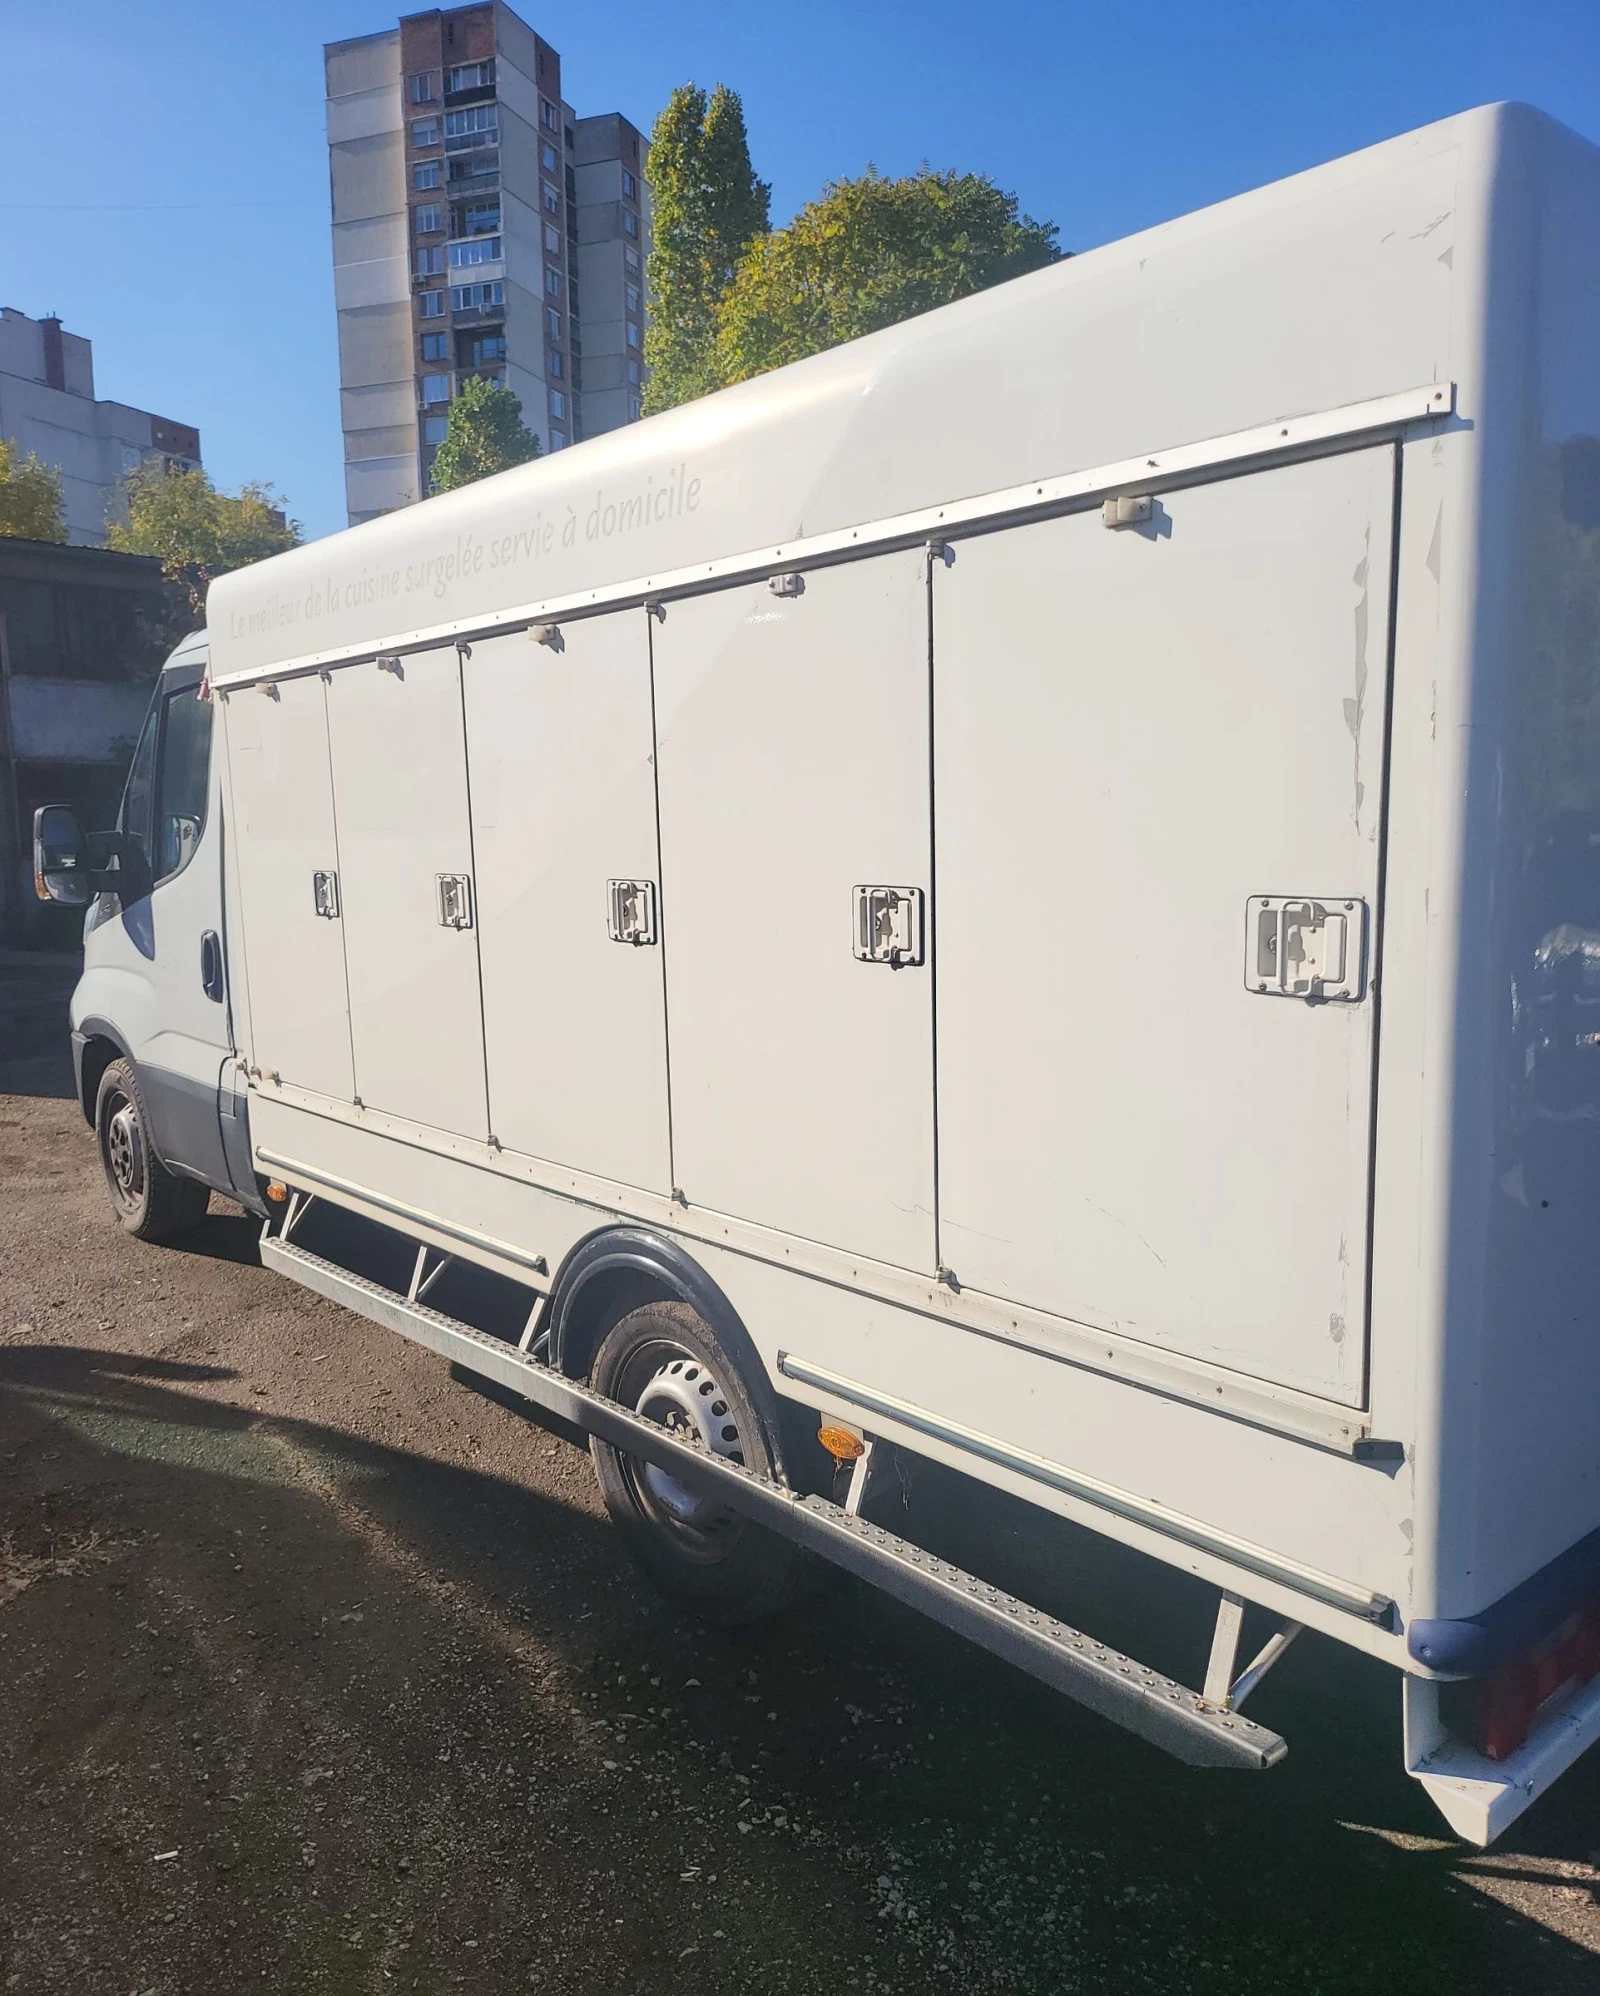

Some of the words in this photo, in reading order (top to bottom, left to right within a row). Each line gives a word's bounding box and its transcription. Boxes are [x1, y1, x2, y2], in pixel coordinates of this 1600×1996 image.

[248, 593, 302, 635] meilleur
[304, 582, 322, 620] de
[326, 577, 340, 615] la
[344, 564, 400, 609] cuisine
[405, 532, 484, 599] surgelée
[490, 511, 554, 569] servie
[561, 505, 577, 549] à
[585, 463, 703, 543] domicile
